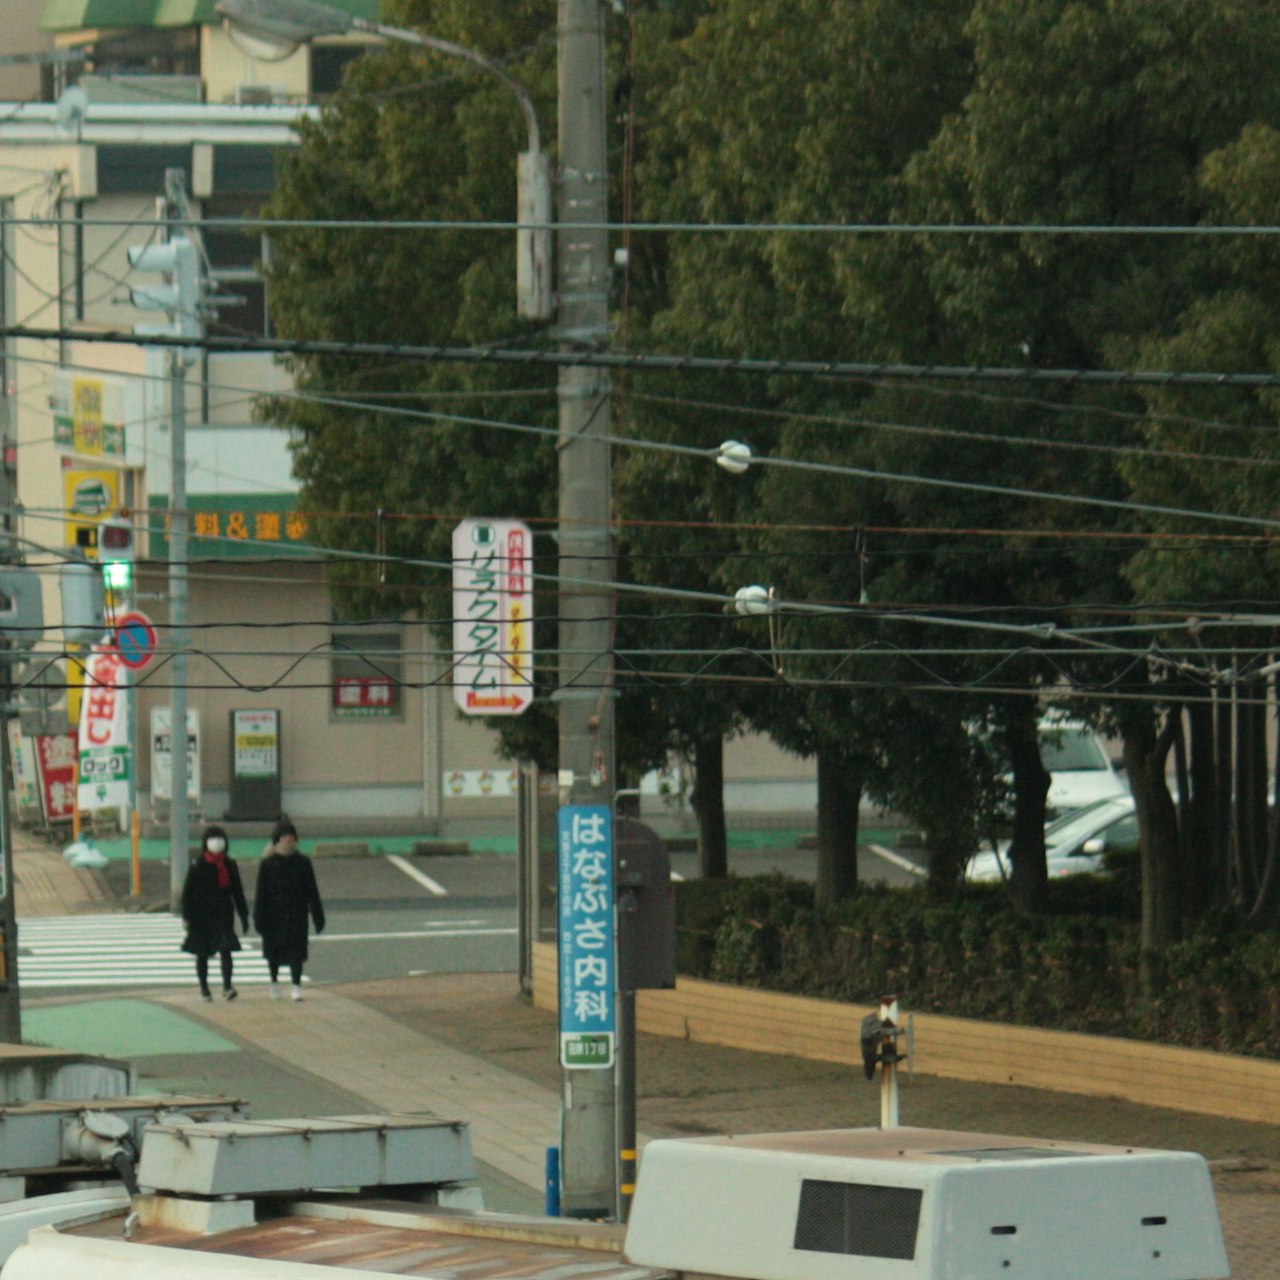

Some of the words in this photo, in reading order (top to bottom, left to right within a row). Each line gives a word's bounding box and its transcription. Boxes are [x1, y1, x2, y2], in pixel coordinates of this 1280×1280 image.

[467, 549, 498, 691] リラクタイム
[83, 756, 121, 773] ロック
[571, 813, 609, 1023] はなぶさ内科
